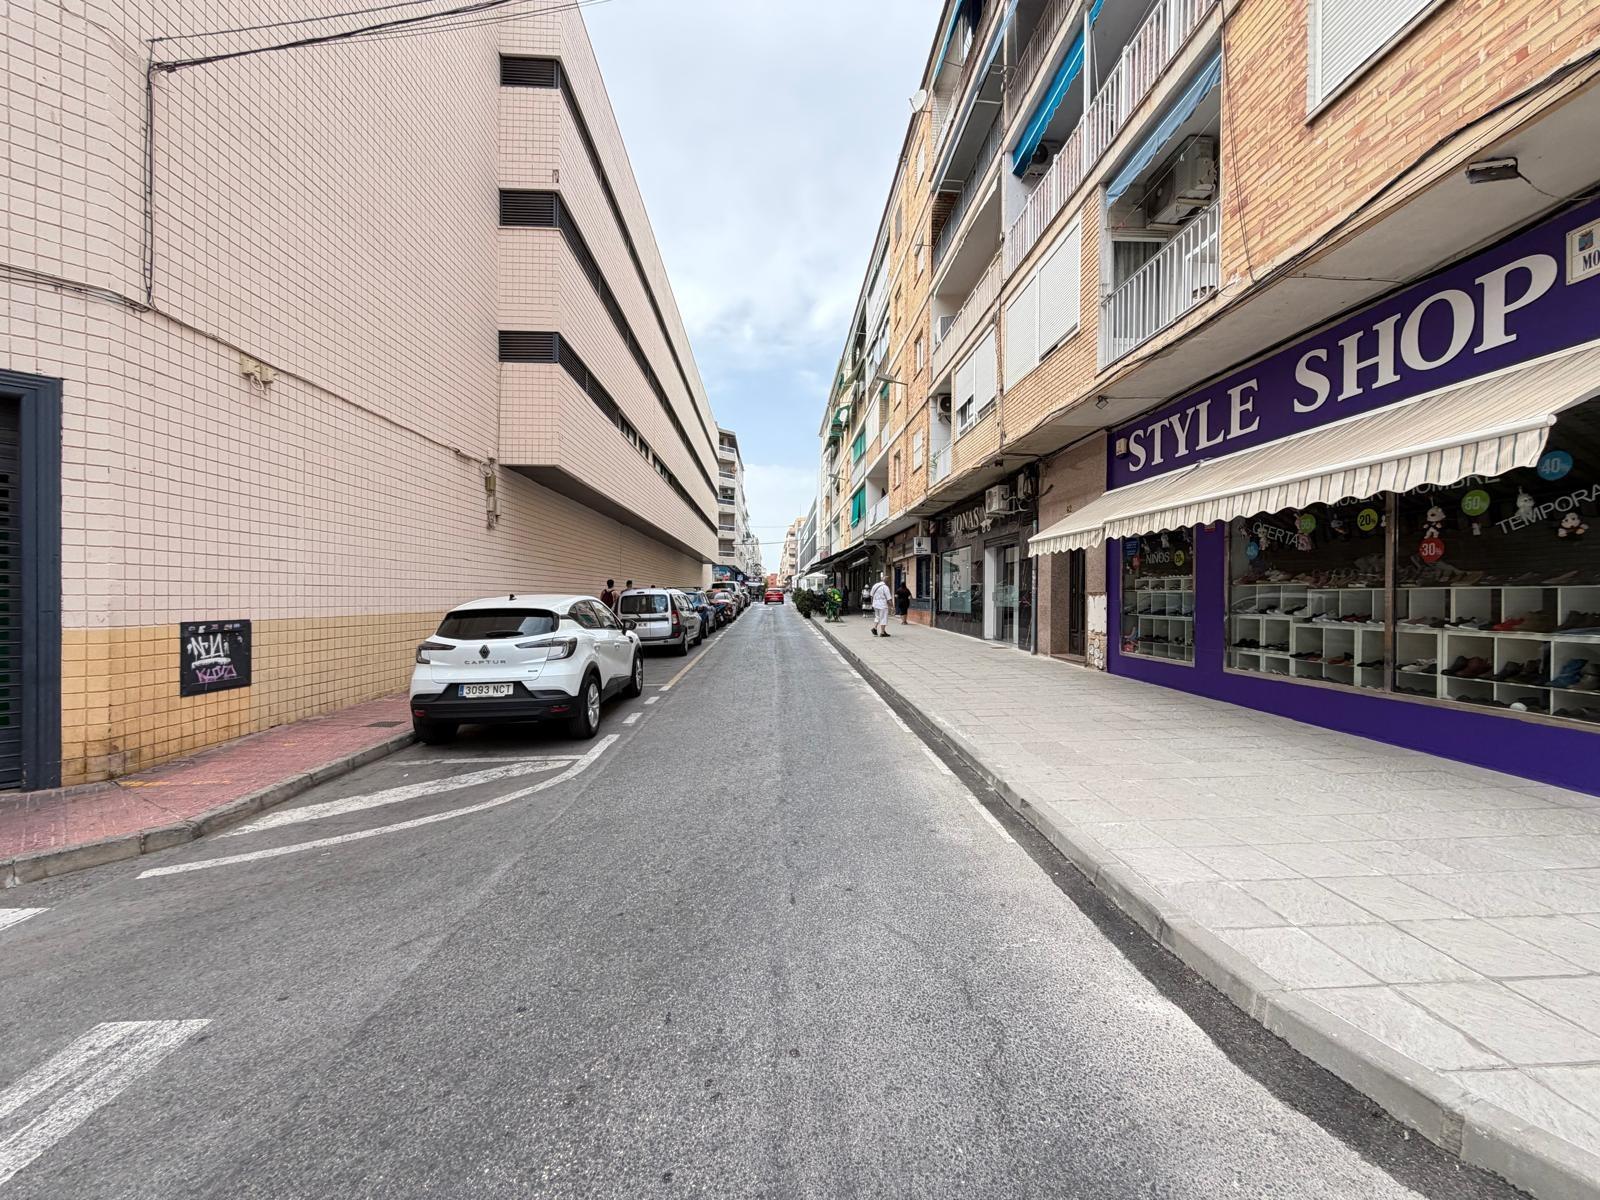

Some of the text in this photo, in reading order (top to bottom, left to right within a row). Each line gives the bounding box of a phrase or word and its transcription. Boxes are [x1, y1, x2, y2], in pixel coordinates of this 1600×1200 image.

[1129, 254, 1557, 472] STYLE SHOP
[1253, 522, 1307, 551] OFERTAS
[465, 684, 512, 695] 3093 NCT
